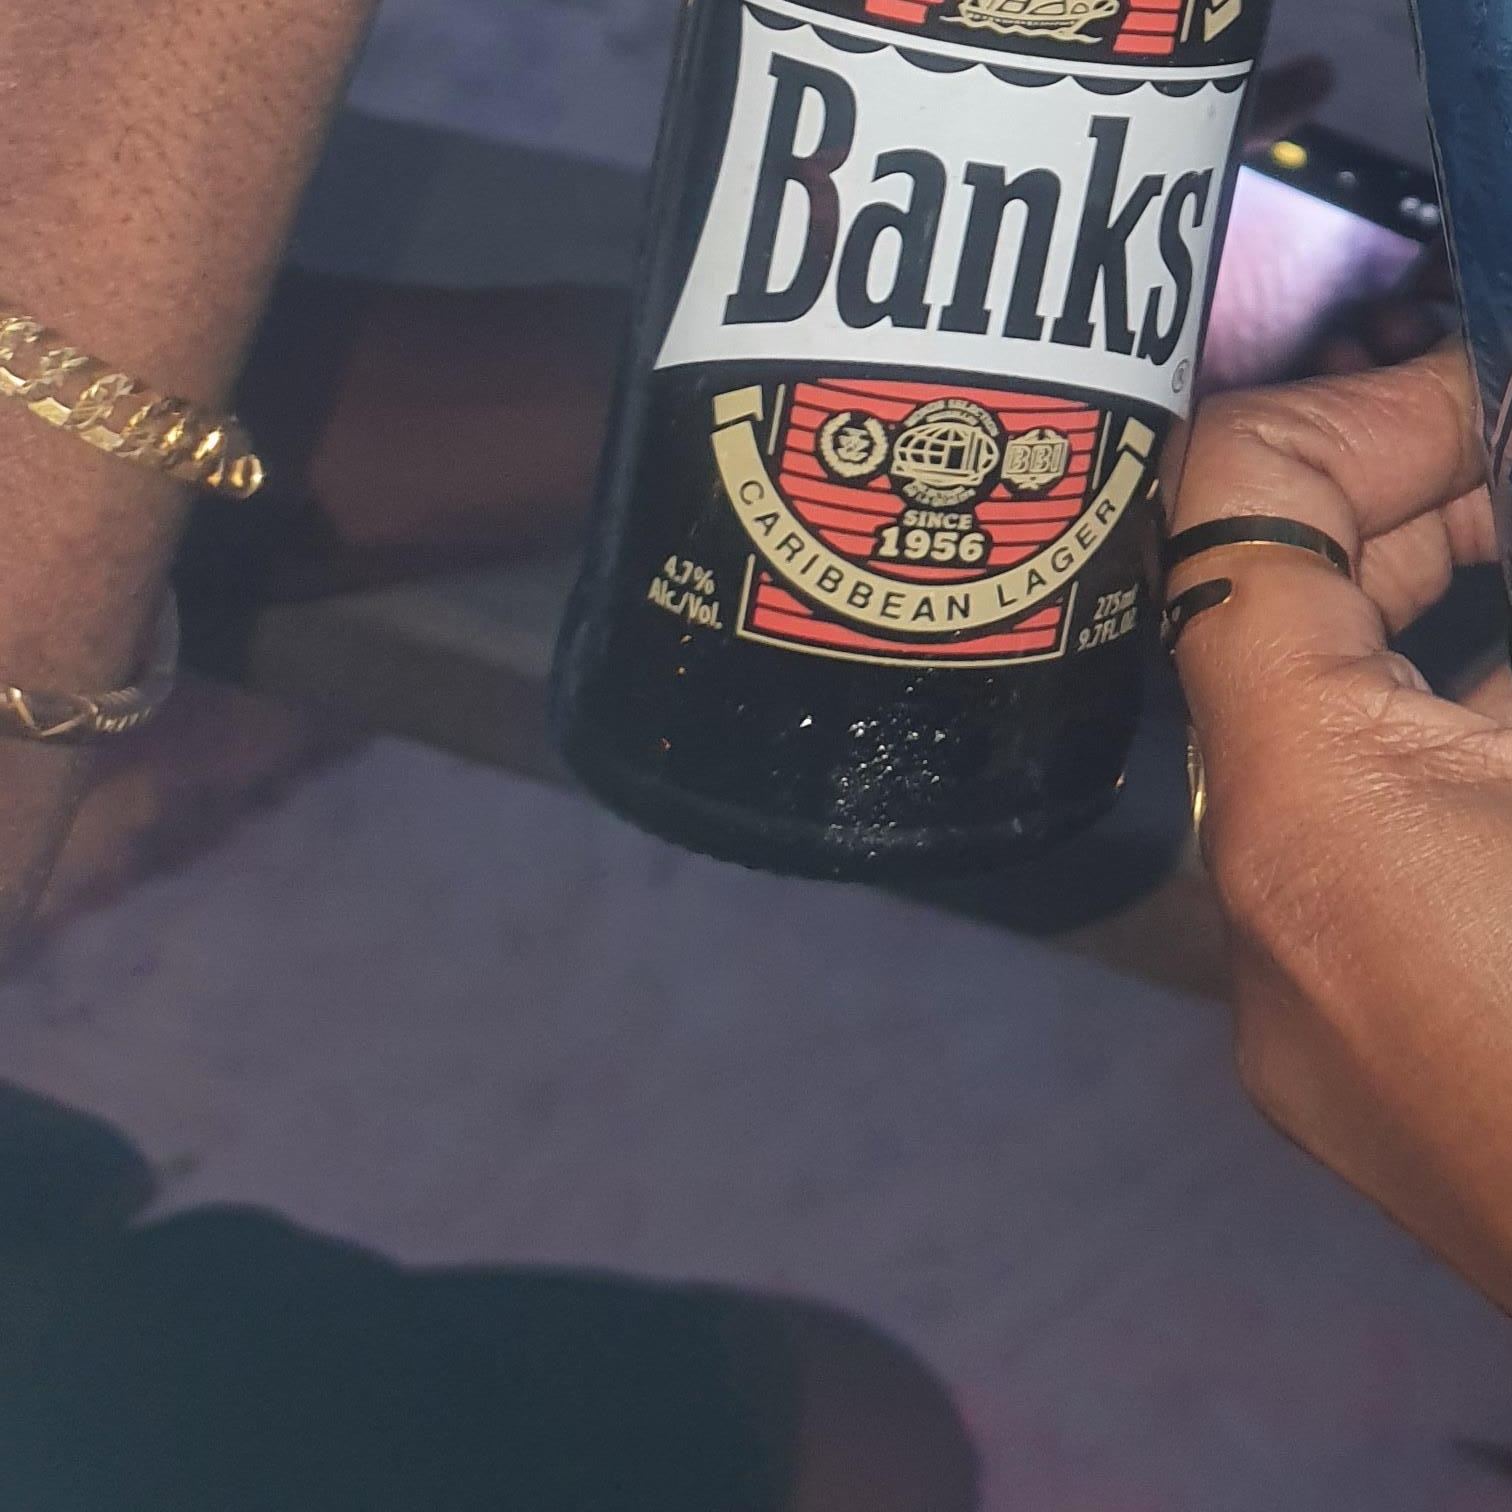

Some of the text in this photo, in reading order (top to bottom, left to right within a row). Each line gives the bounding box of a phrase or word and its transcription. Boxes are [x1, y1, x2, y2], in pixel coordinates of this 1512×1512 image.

[721, 52, 1214, 366] Banks
[903, 508, 973, 531] SINCE
[738, 479, 1119, 622] CARIBBEAN LAGER
[880, 526, 985, 563] 1956
[664, 554, 715, 596] 4.7%
